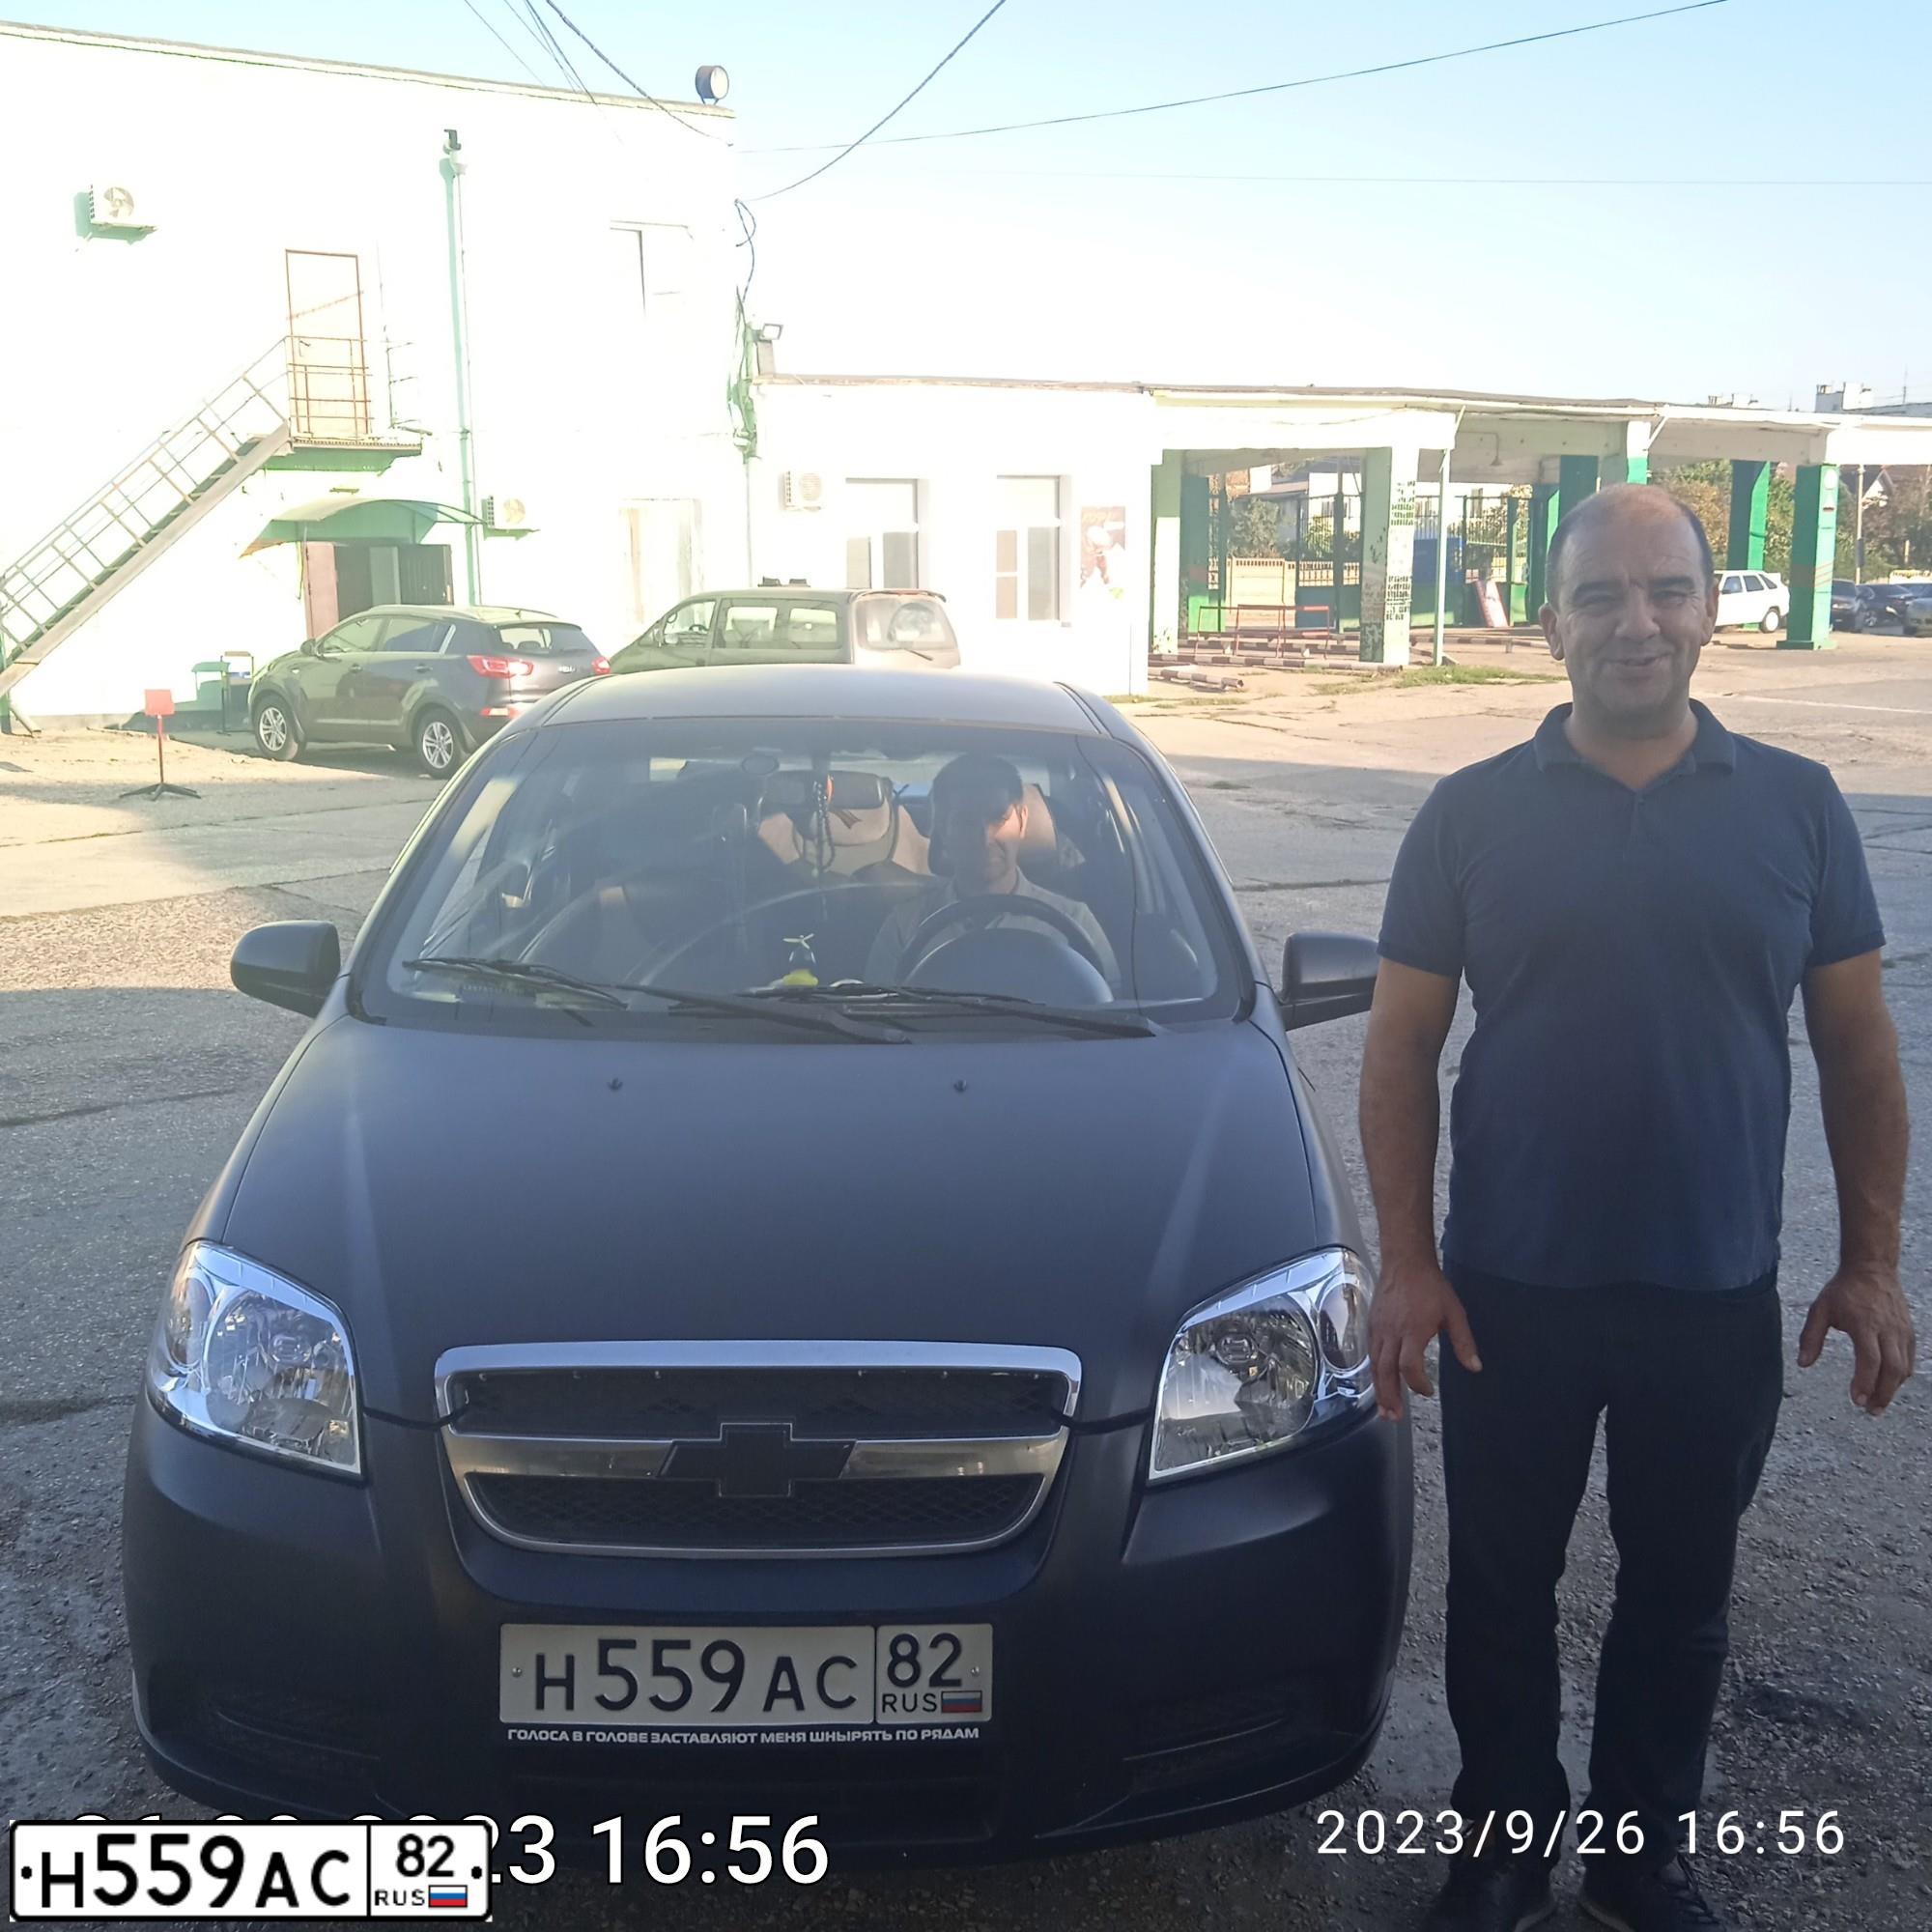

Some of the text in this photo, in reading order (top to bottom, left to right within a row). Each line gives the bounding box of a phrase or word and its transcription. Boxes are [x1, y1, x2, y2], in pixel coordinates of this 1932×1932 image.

[534, 1638, 858, 1713] Н559АС
[887, 1633, 963, 1688] 82
[881, 1692, 938, 1713] RUS
[507, 1726, 980, 1745] ГОЛОСА В ГОЛОВЕ ЗАСТАВЛЯЮТ МЕНЯ ШНЫРЯТЬ ПО РЯДАМ
